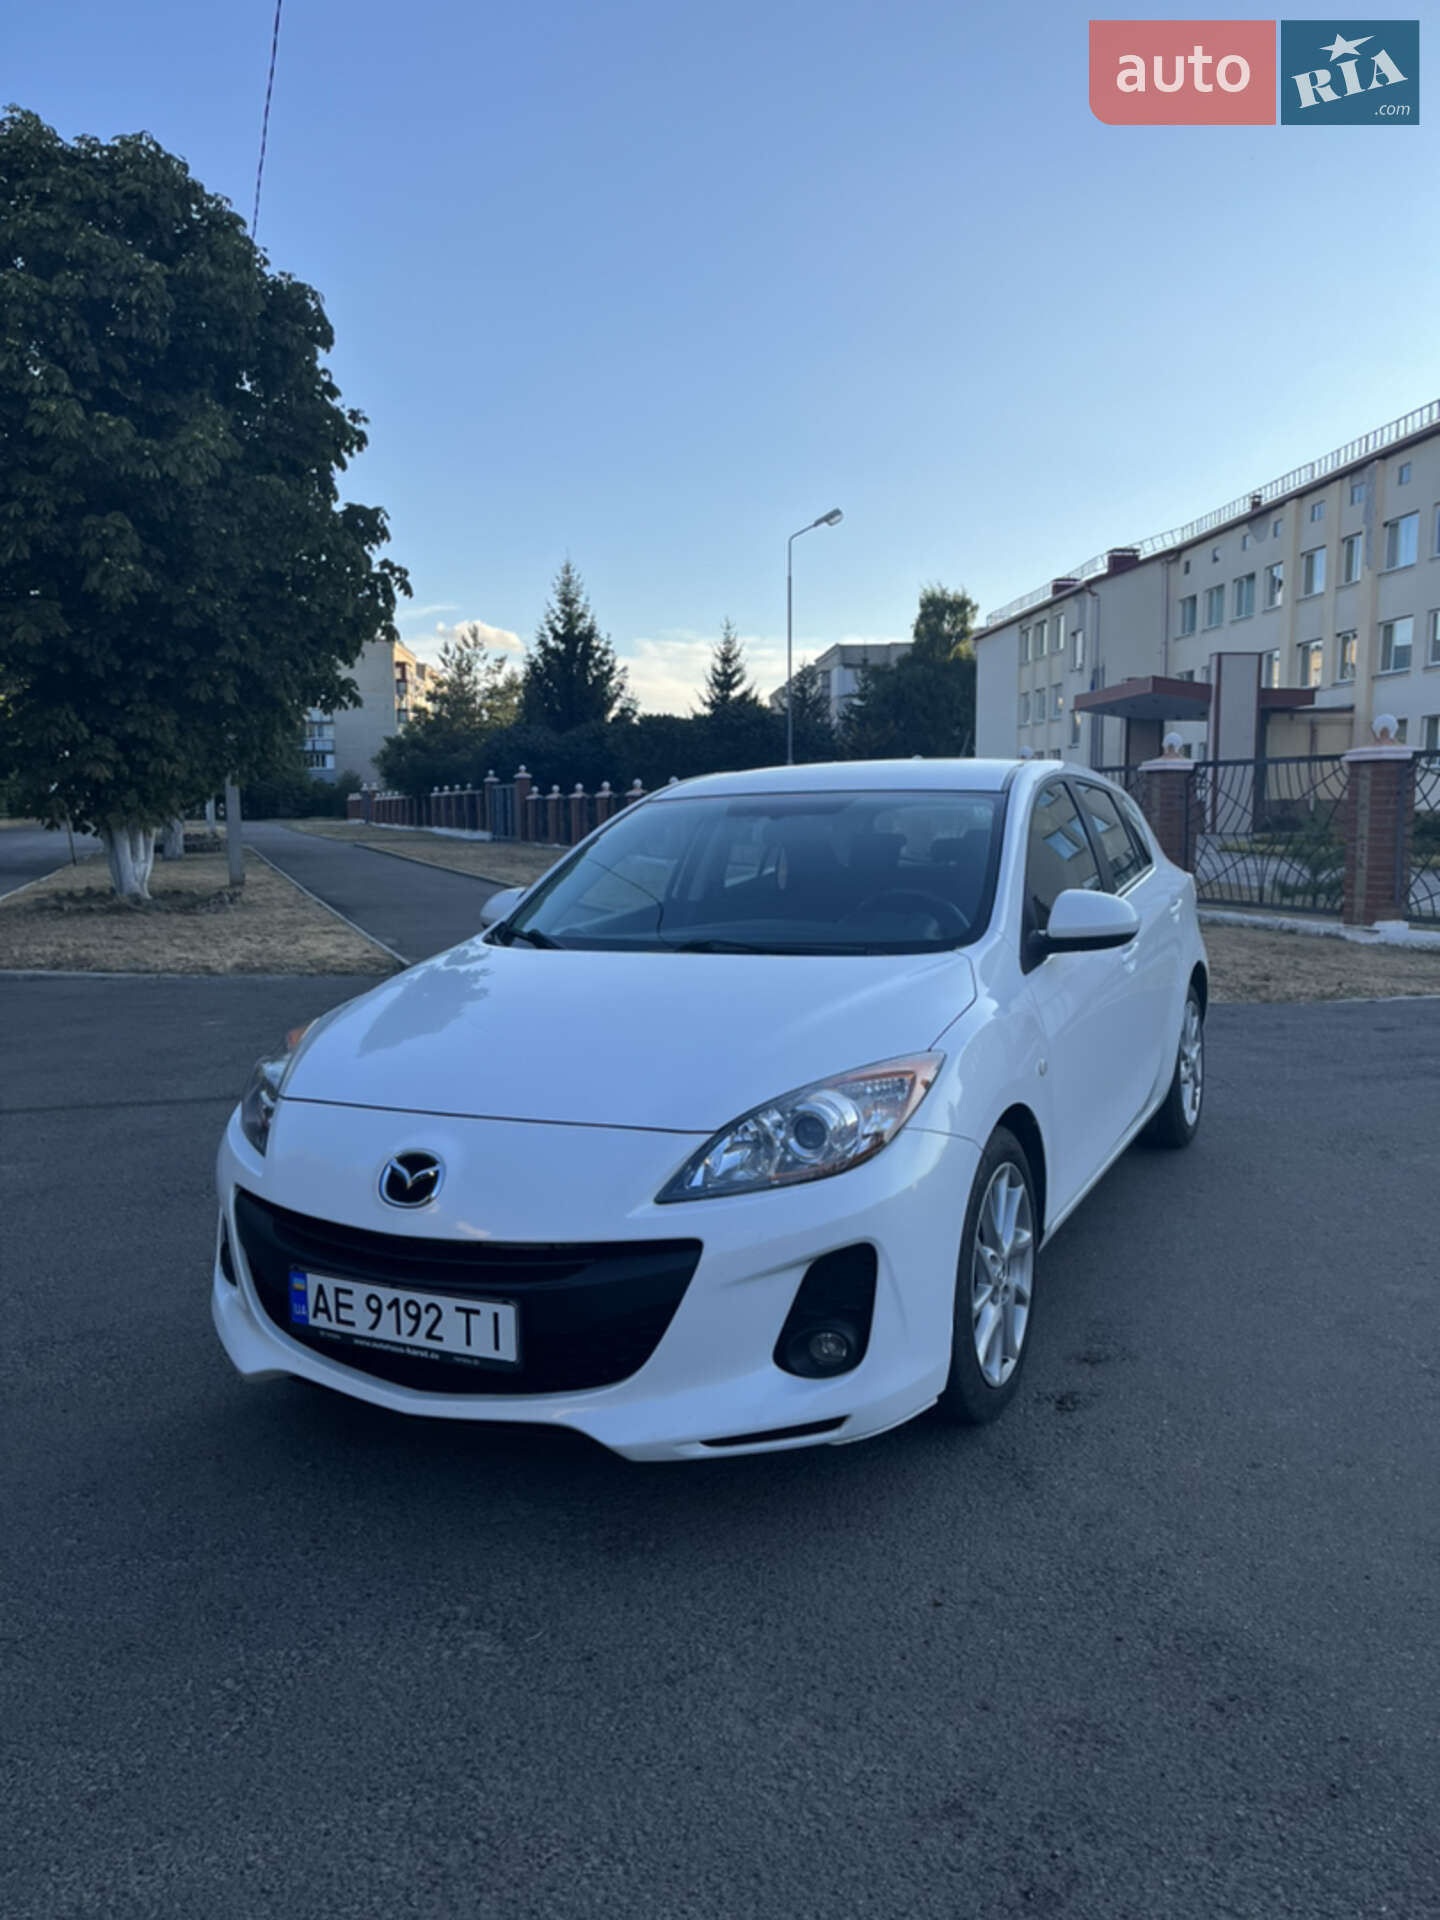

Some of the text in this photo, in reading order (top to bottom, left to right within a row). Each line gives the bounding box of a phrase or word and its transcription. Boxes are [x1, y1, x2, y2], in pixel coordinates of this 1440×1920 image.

[312, 1283, 500, 1351] AE 9192 TI
